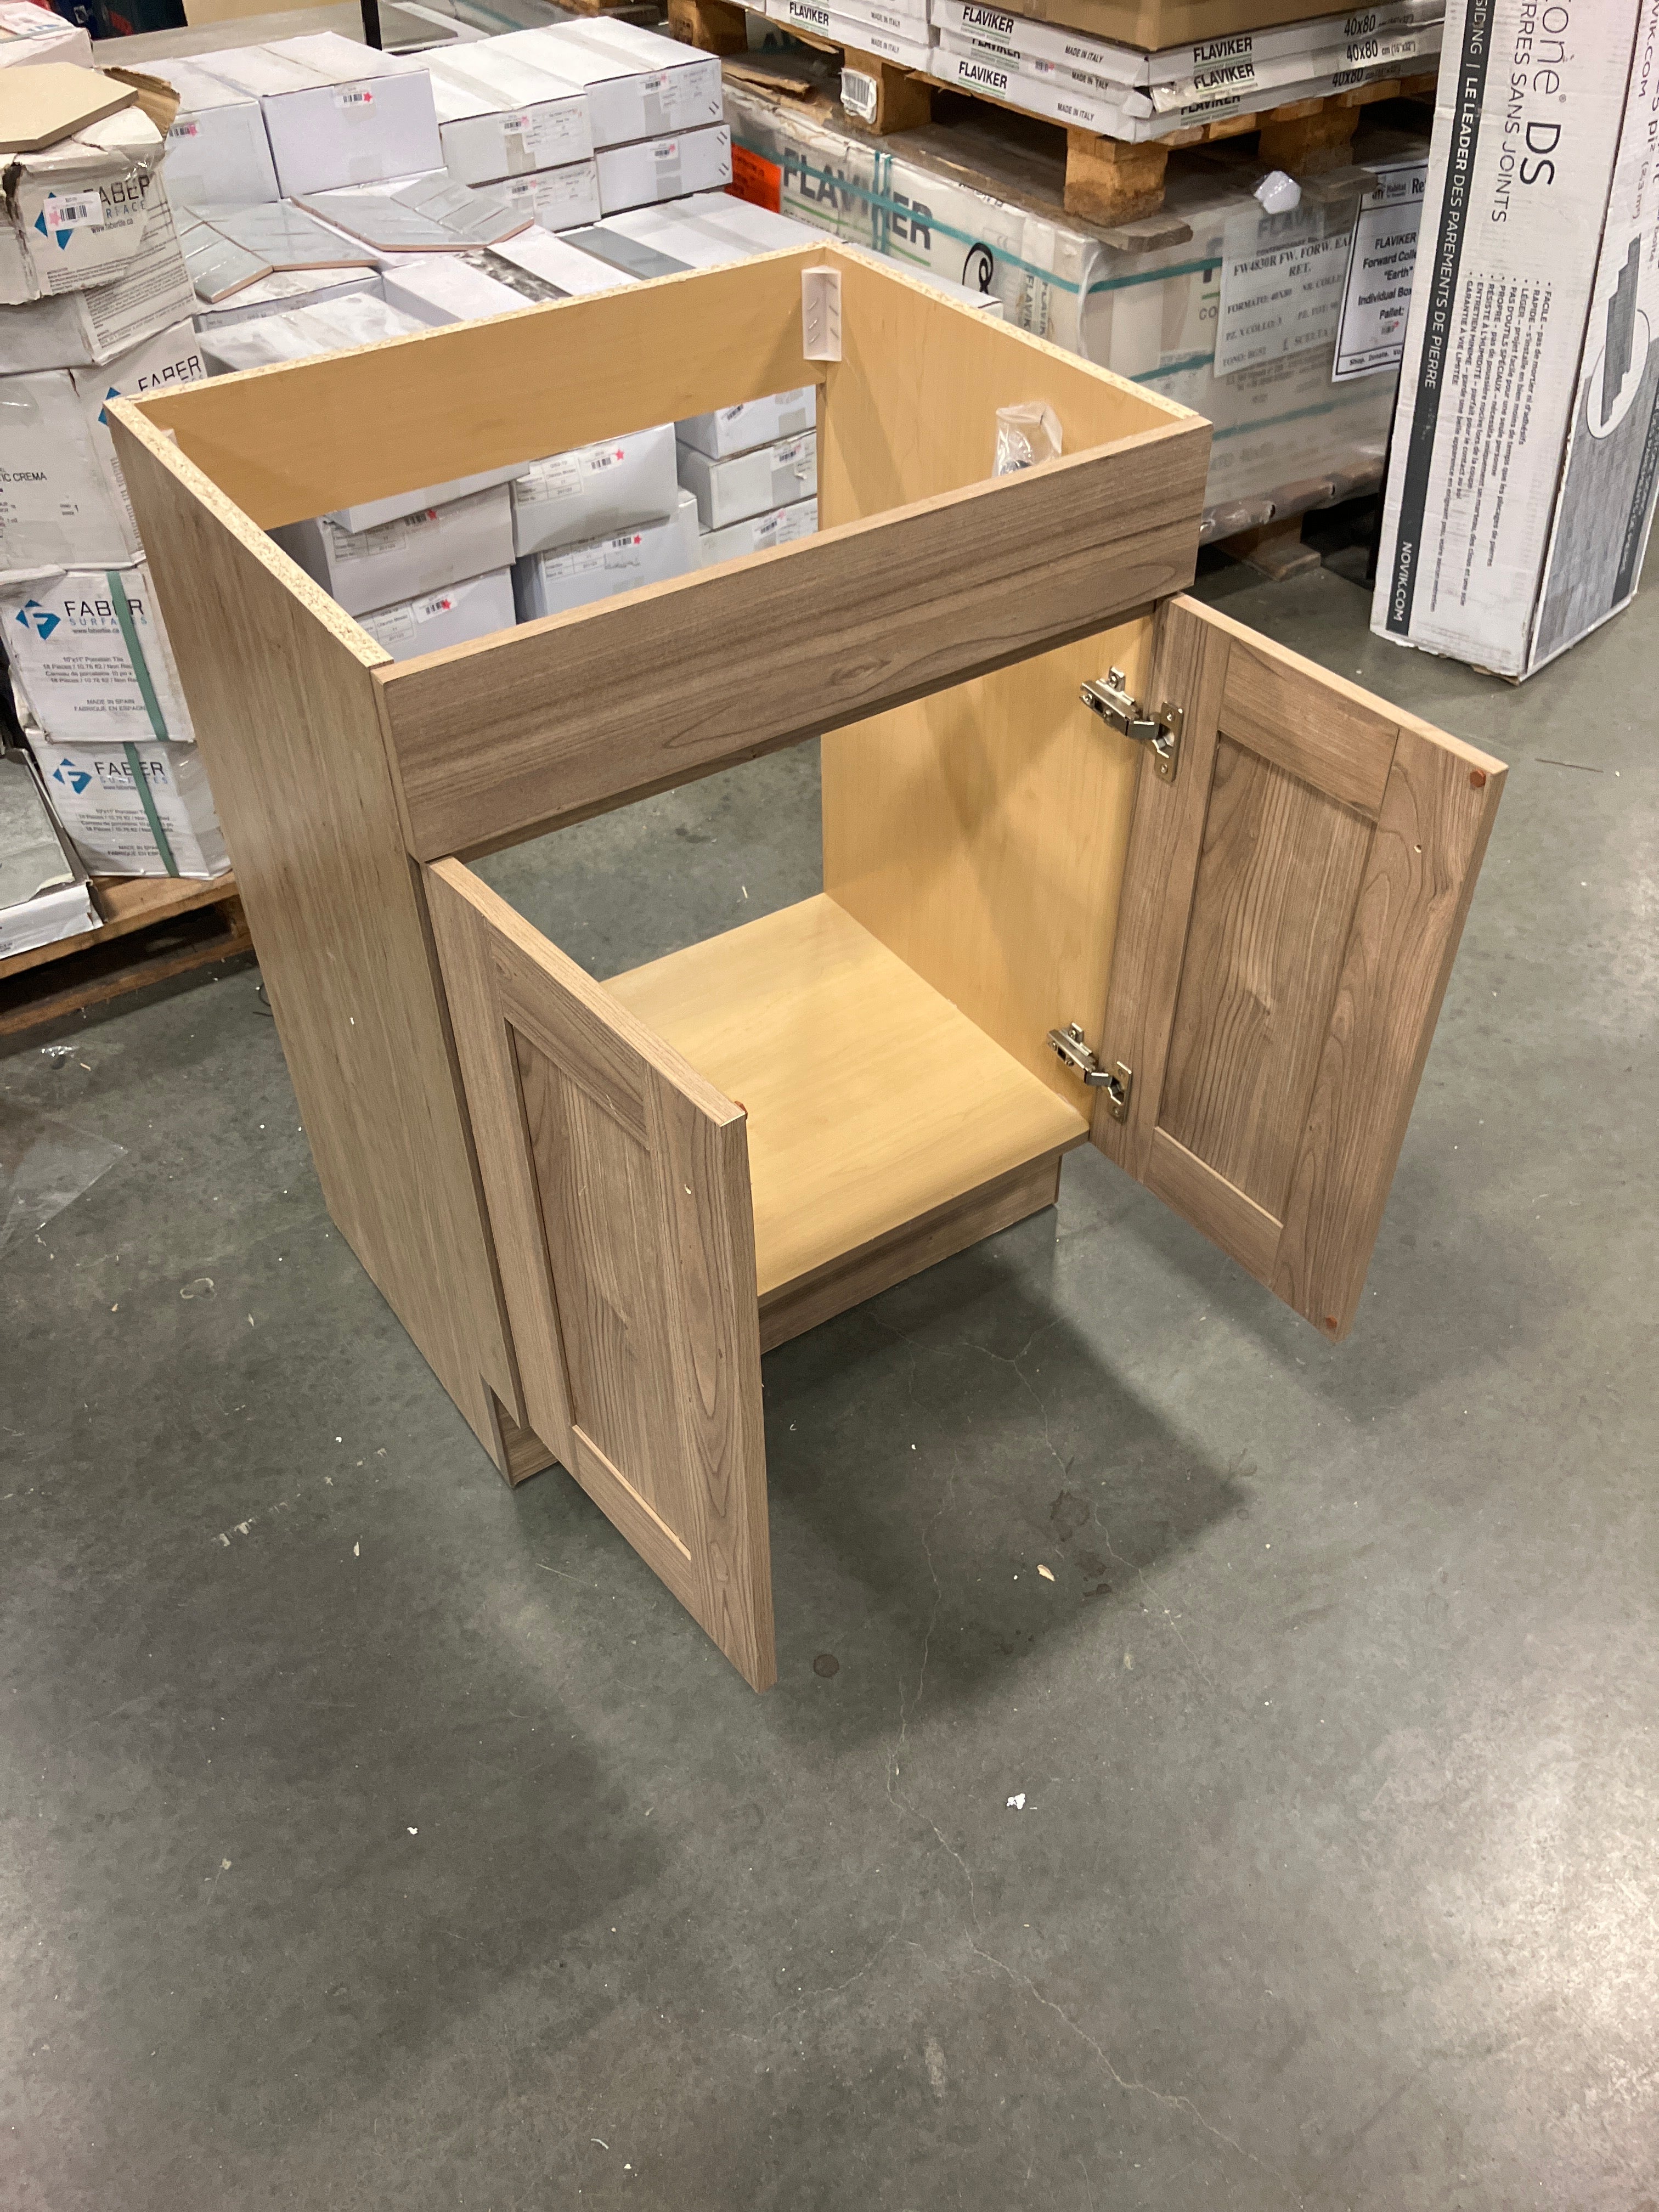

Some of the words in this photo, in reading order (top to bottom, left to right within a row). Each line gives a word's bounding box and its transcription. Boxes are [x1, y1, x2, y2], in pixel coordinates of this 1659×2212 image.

[789, 2, 830, 26] FLAVIKER
[963, 5, 1014, 33] FLAVIKER
[1344, 14, 1376, 37] 40x80
[1470, 0, 1488, 54] SIDNG
[1514, 0, 1537, 65] RRES
[1533, 0, 1571, 93] one
[1065, 44, 1081, 57] MADE
[1081, 50, 1087, 58] IN
[1087, 52, 1104, 63] ITALY
[1194, 37, 1252, 63] FLAVIKER
[1347, 40, 1378, 62] 40x80
[1639, 0, 1659, 97] VIK.COM
[959, 61, 1007, 89] FLAVIKER
[1194, 63, 1255, 89] FLAVIKER
[1332, 67, 1363, 87] 40x80
[1465, 77, 1479, 98] LE
[1505, 73, 1526, 133] SANS
[1456, 103, 1475, 171] LEADER
[1520, 122, 1561, 185] DS
[1451, 175, 1465, 207] DES
[1492, 142, 1516, 222] JOINTS
[1375, 232, 1416, 250] FLAVIKER
[1363, 253, 1397, 269] Forward
[1436, 211, 1460, 308] PAREMENTS
[1358, 288, 1396, 306] Individual
[1460, 280, 1473, 325] GARANTIE
[1471, 282, 1484, 332] ENTRETIEN
[1494, 285, 1506, 322] PROPRE
[1508, 286, 1517, 304] PAS
[1528, 290, 1540, 323] RAPIDE
[1540, 291, 1552, 322] FACILE
[1432, 311, 1446, 332] DE
[1502, 306, 1514, 347] D'OUTILS
[1457, 336, 1465, 351] VIE
[1534, 348, 1541, 359] de
[1425, 336, 1442, 388] PIERRE
[13, 472, 47, 482] CREMA
[1393, 541, 1412, 622] NOVIK.COM
